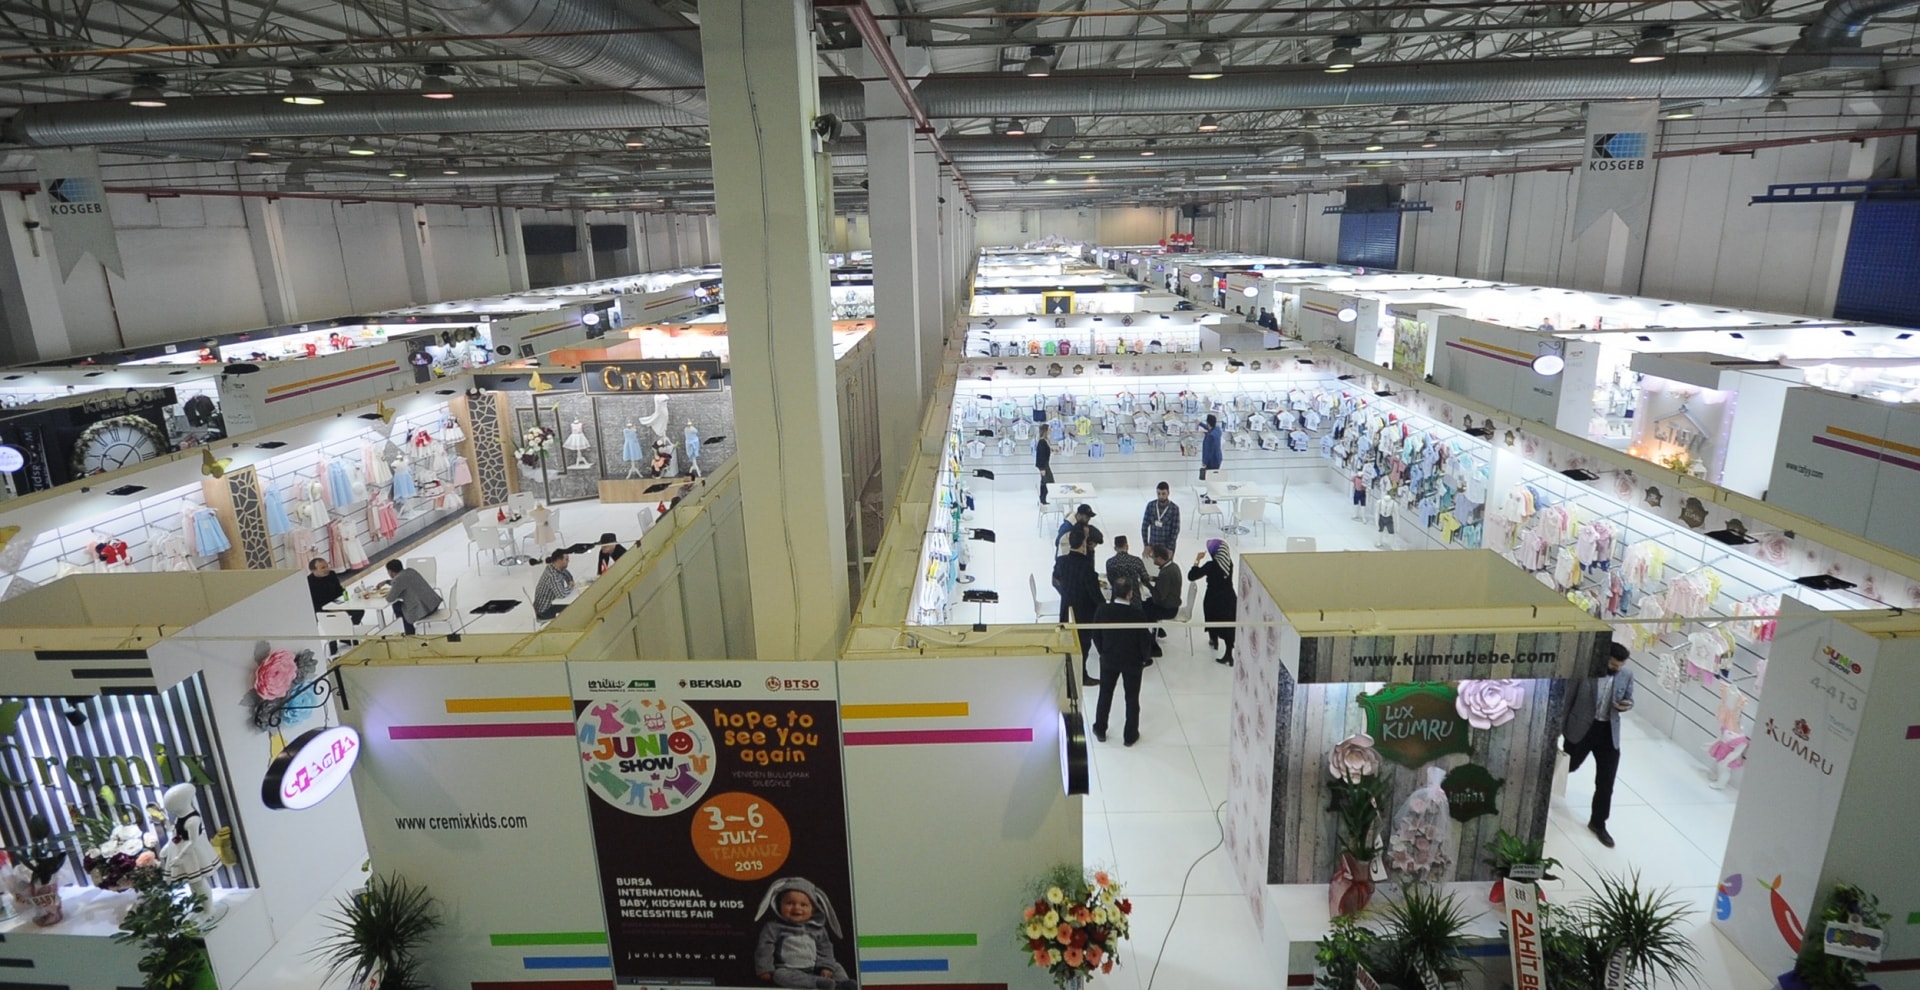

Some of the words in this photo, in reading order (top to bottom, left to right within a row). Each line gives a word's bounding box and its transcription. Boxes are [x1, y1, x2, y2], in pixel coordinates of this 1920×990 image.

[1589, 159, 1645, 172] KOSGEB
[50, 202, 103, 216] KOSGEB
[603, 363, 710, 392] Cremix
[1353, 650, 1556, 667] www.kumrubebe.com
[689, 678, 742, 689] BEKSİAD
[783, 679, 820, 688] BTSO
[713, 708, 778, 730] hope
[786, 710, 814, 729] to
[1385, 704, 1414, 722] LUX
[724, 728, 767, 747] see
[776, 727, 818, 748] you
[1382, 719, 1454, 742] KUMRU
[592, 731, 694, 760] JUNIO
[1765, 717, 1835, 776] KUMRU
[740, 746, 806, 766] again
[618, 756, 674, 774] SHOW
[709, 843, 782, 861] TEMMUZ
[734, 860, 763, 873] 2019
[616, 877, 653, 887] BURSA
[618, 888, 703, 898] INTERNATIONAL
[619, 899, 649, 909] BABY,
[651, 899, 707, 909] KIDSWEAR
[709, 899, 717, 908] &
[719, 900, 745, 909] KIDS
[621, 909, 688, 919] NECESSITIES
[690, 910, 714, 919] FAIR
[628, 951, 737, 961] junioshow.com
